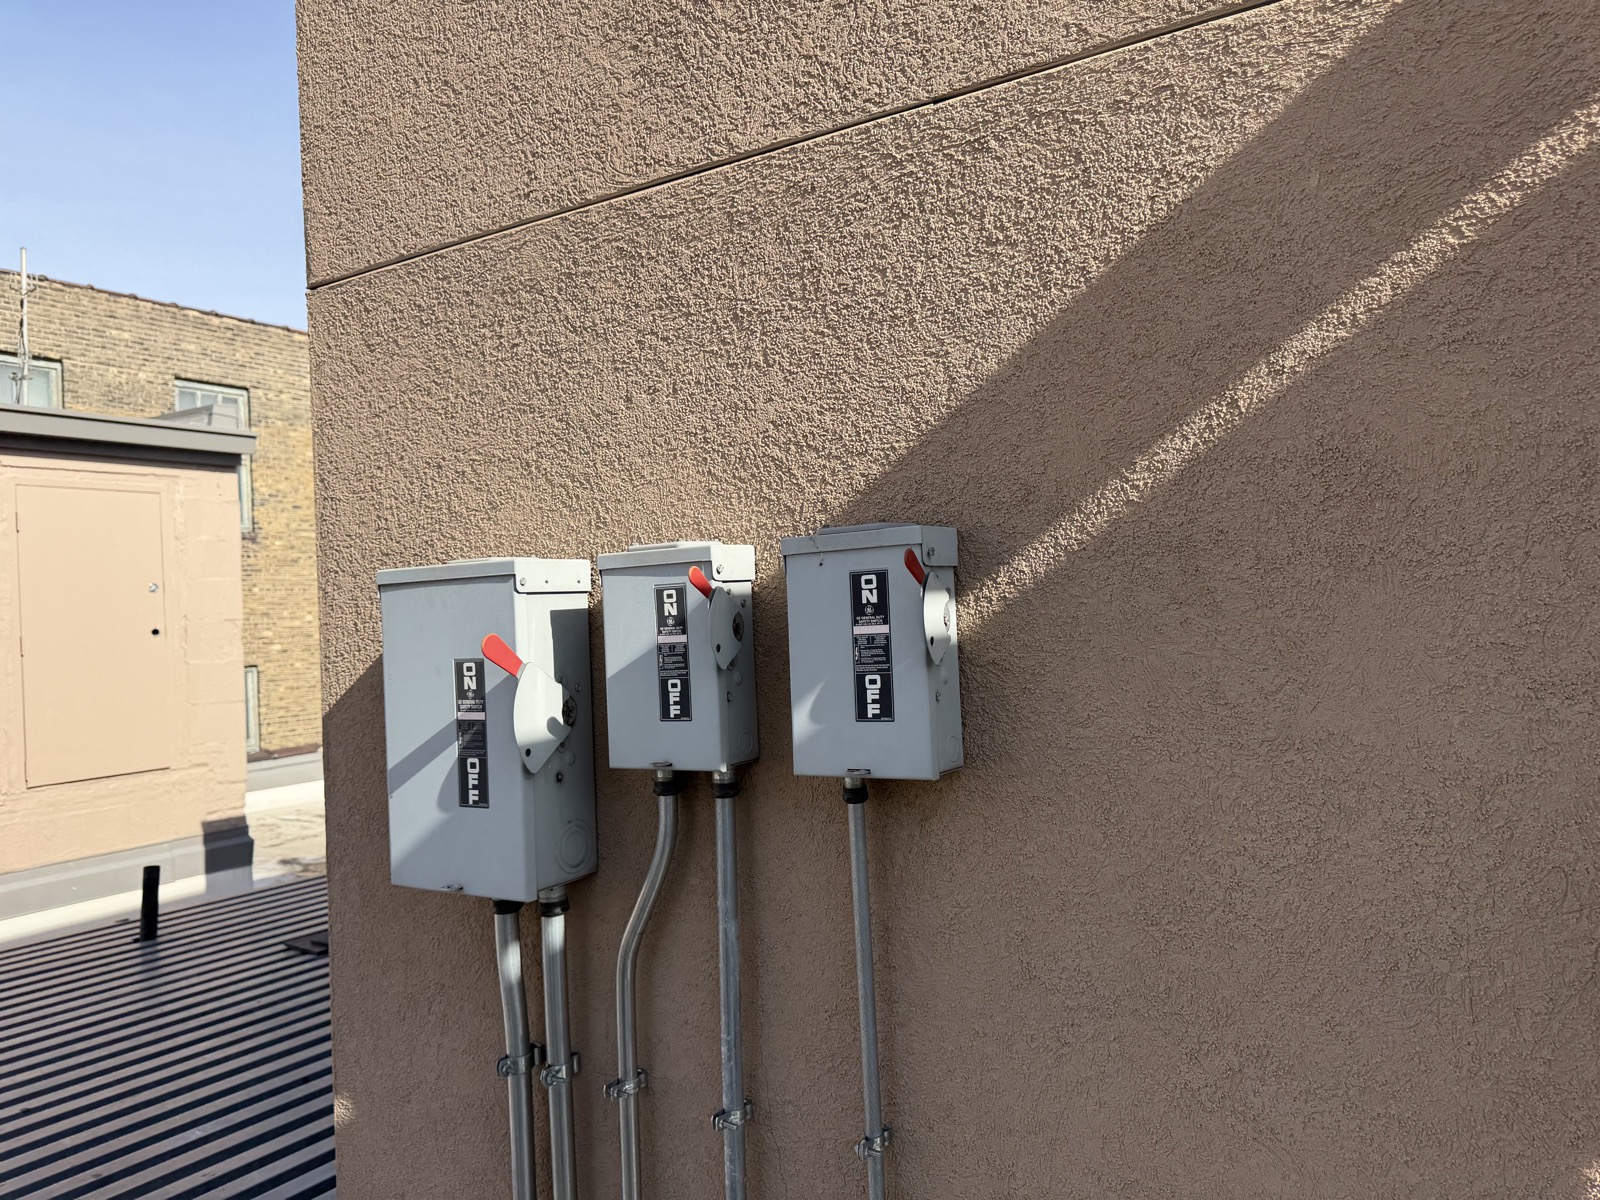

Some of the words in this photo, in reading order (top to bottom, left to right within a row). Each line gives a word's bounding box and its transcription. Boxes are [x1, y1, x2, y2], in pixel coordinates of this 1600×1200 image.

[663, 589, 678, 616] ON
[861, 574, 878, 604] ON
[463, 662, 477, 690] ON
[668, 679, 681, 718] OFF
[865, 674, 881, 718] OFF
[467, 757, 480, 805] OFF
